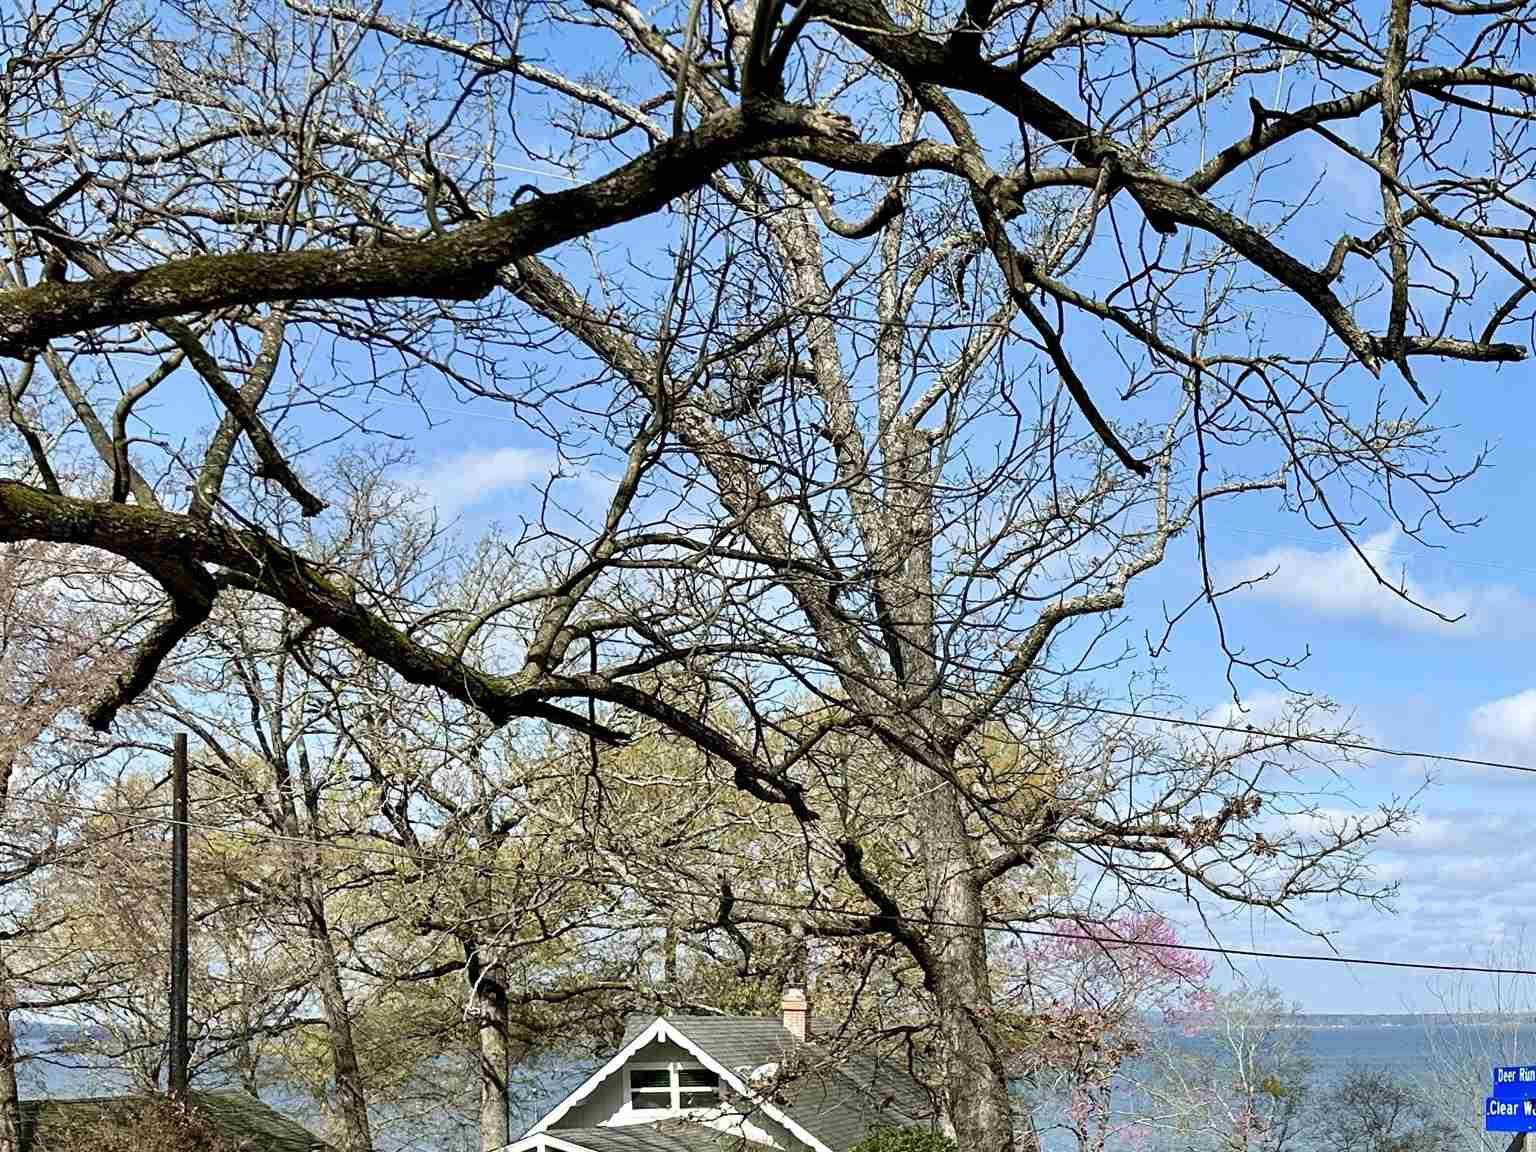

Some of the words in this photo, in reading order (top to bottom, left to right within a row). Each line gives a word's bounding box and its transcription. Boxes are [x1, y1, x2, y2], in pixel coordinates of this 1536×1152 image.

[1498, 1068, 1516, 1082] Deer
[1519, 1067, 1536, 1082] Run
[1489, 1100, 1518, 1116] Clear
